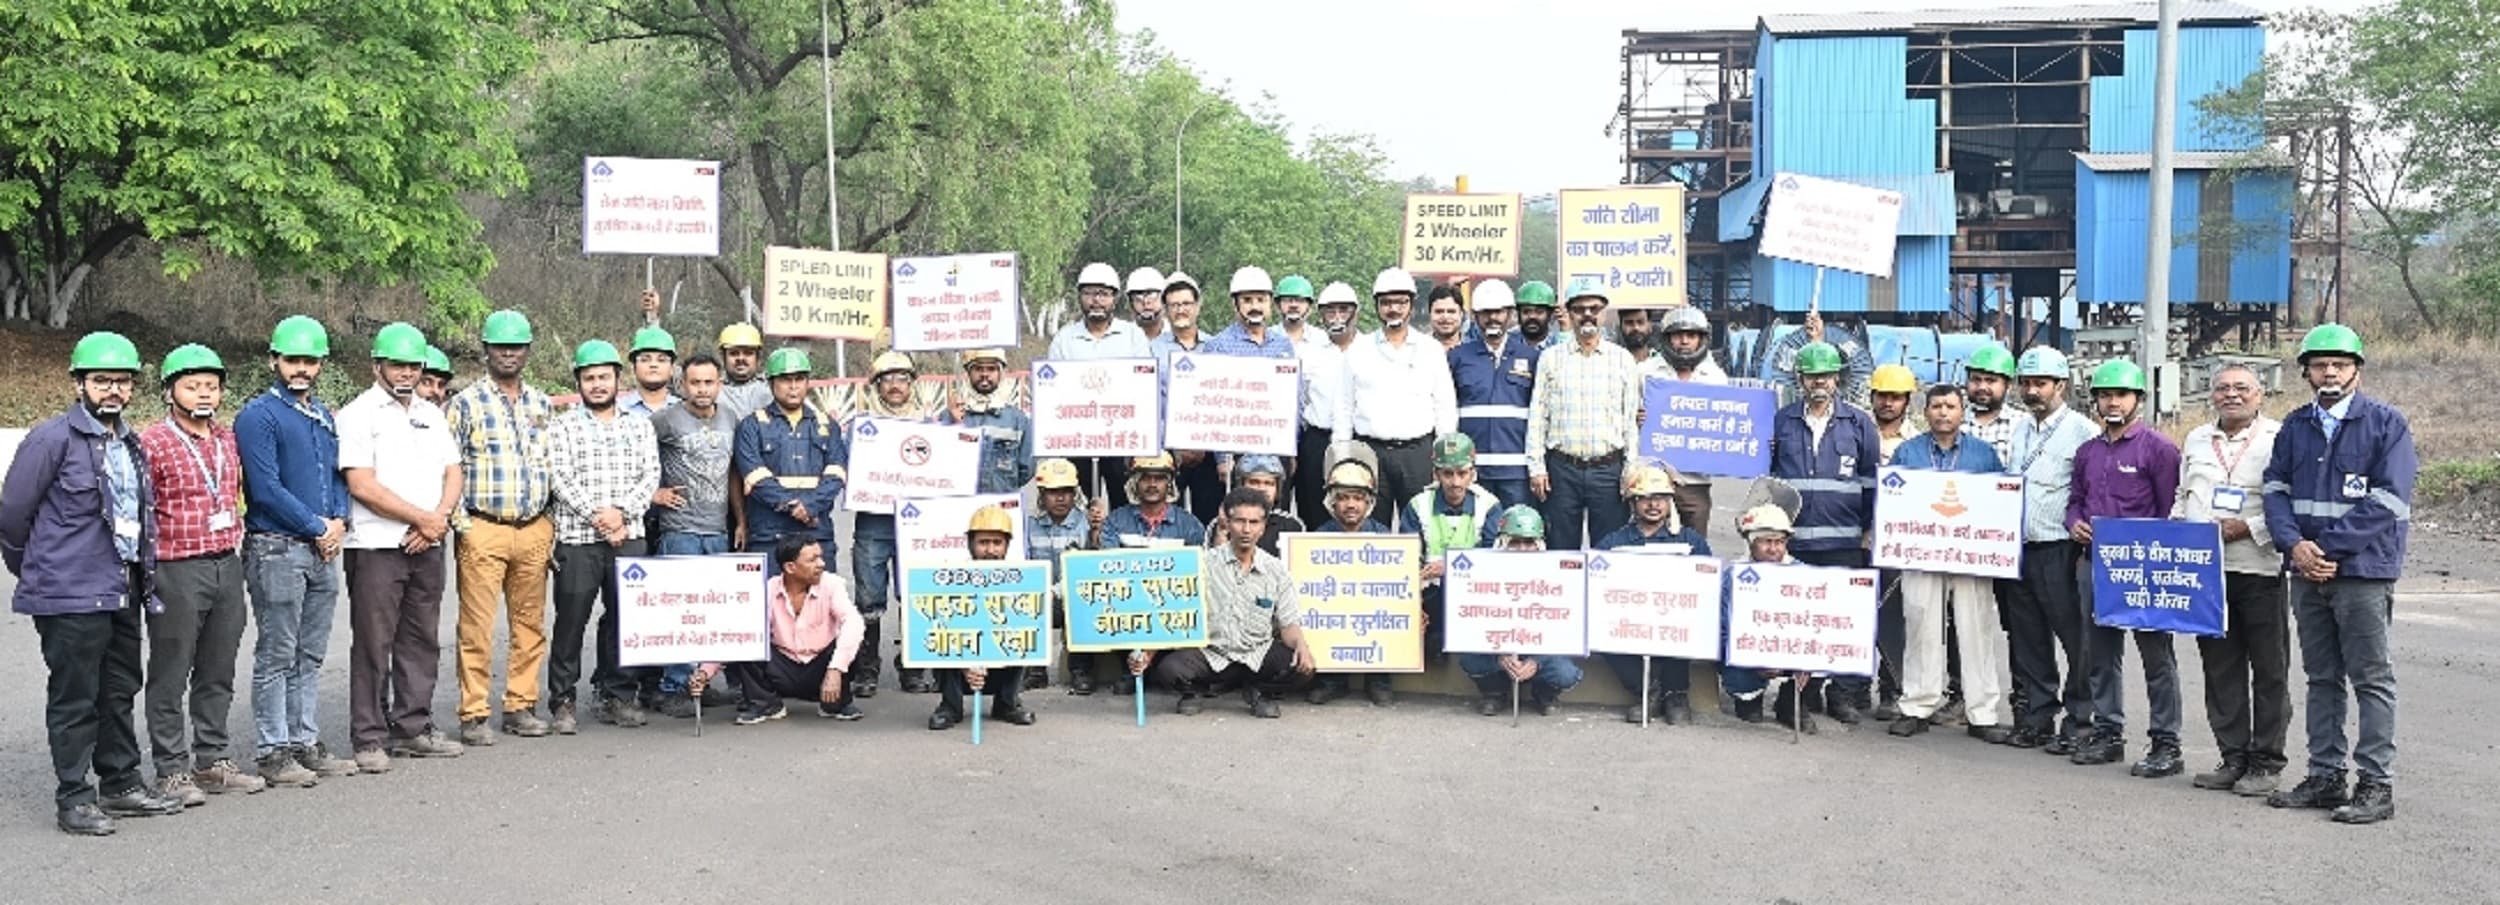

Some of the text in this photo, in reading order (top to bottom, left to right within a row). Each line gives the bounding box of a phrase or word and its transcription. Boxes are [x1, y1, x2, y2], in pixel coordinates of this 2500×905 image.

[1417, 203, 1508, 218] SPEED LIMIT
[1583, 201, 1661, 225] गति सीमा
[1414, 223, 1508, 239] 2 Wheeler
[1415, 245, 1505, 264] 30 Km/Hr.
[1566, 241, 1590, 257] का
[1593, 240, 1640, 257] पालन
[834, 263, 873, 281] LIMIT
[778, 279, 876, 303] 2 Wheeler
[780, 304, 874, 328] 30 Km/Hr.
[1055, 400, 1137, 427] आपकी सुरक्षा
[1310, 542, 1405, 566] शराब पीकर
[2131, 540, 2146, 561] के
[2148, 540, 2173, 562] तीन
[2174, 546, 2213, 565] आधार
[1076, 574, 1200, 608] सड़क सुरक्षा
[1299, 575, 1337, 602] गाड़ी
[1341, 582, 1357, 597] न
[1467, 579, 1564, 602] आप सुरक्षित
[2123, 586, 2151, 609] सही
[910, 592, 1045, 625] सड़क सुरक्षा
[1458, 602, 1571, 621] आपका परिवार
[1603, 589, 1699, 616] सड़क सुरक्षा
[1093, 605, 1200, 640] जीवन रक्षा
[1300, 607, 1410, 637] जीवन सुरक्षित
[1609, 617, 1689, 643] जीवन रक्षा
[922, 619, 1041, 660] जीवन रक्षा
[1485, 628, 1543, 650] सुरक्षित
